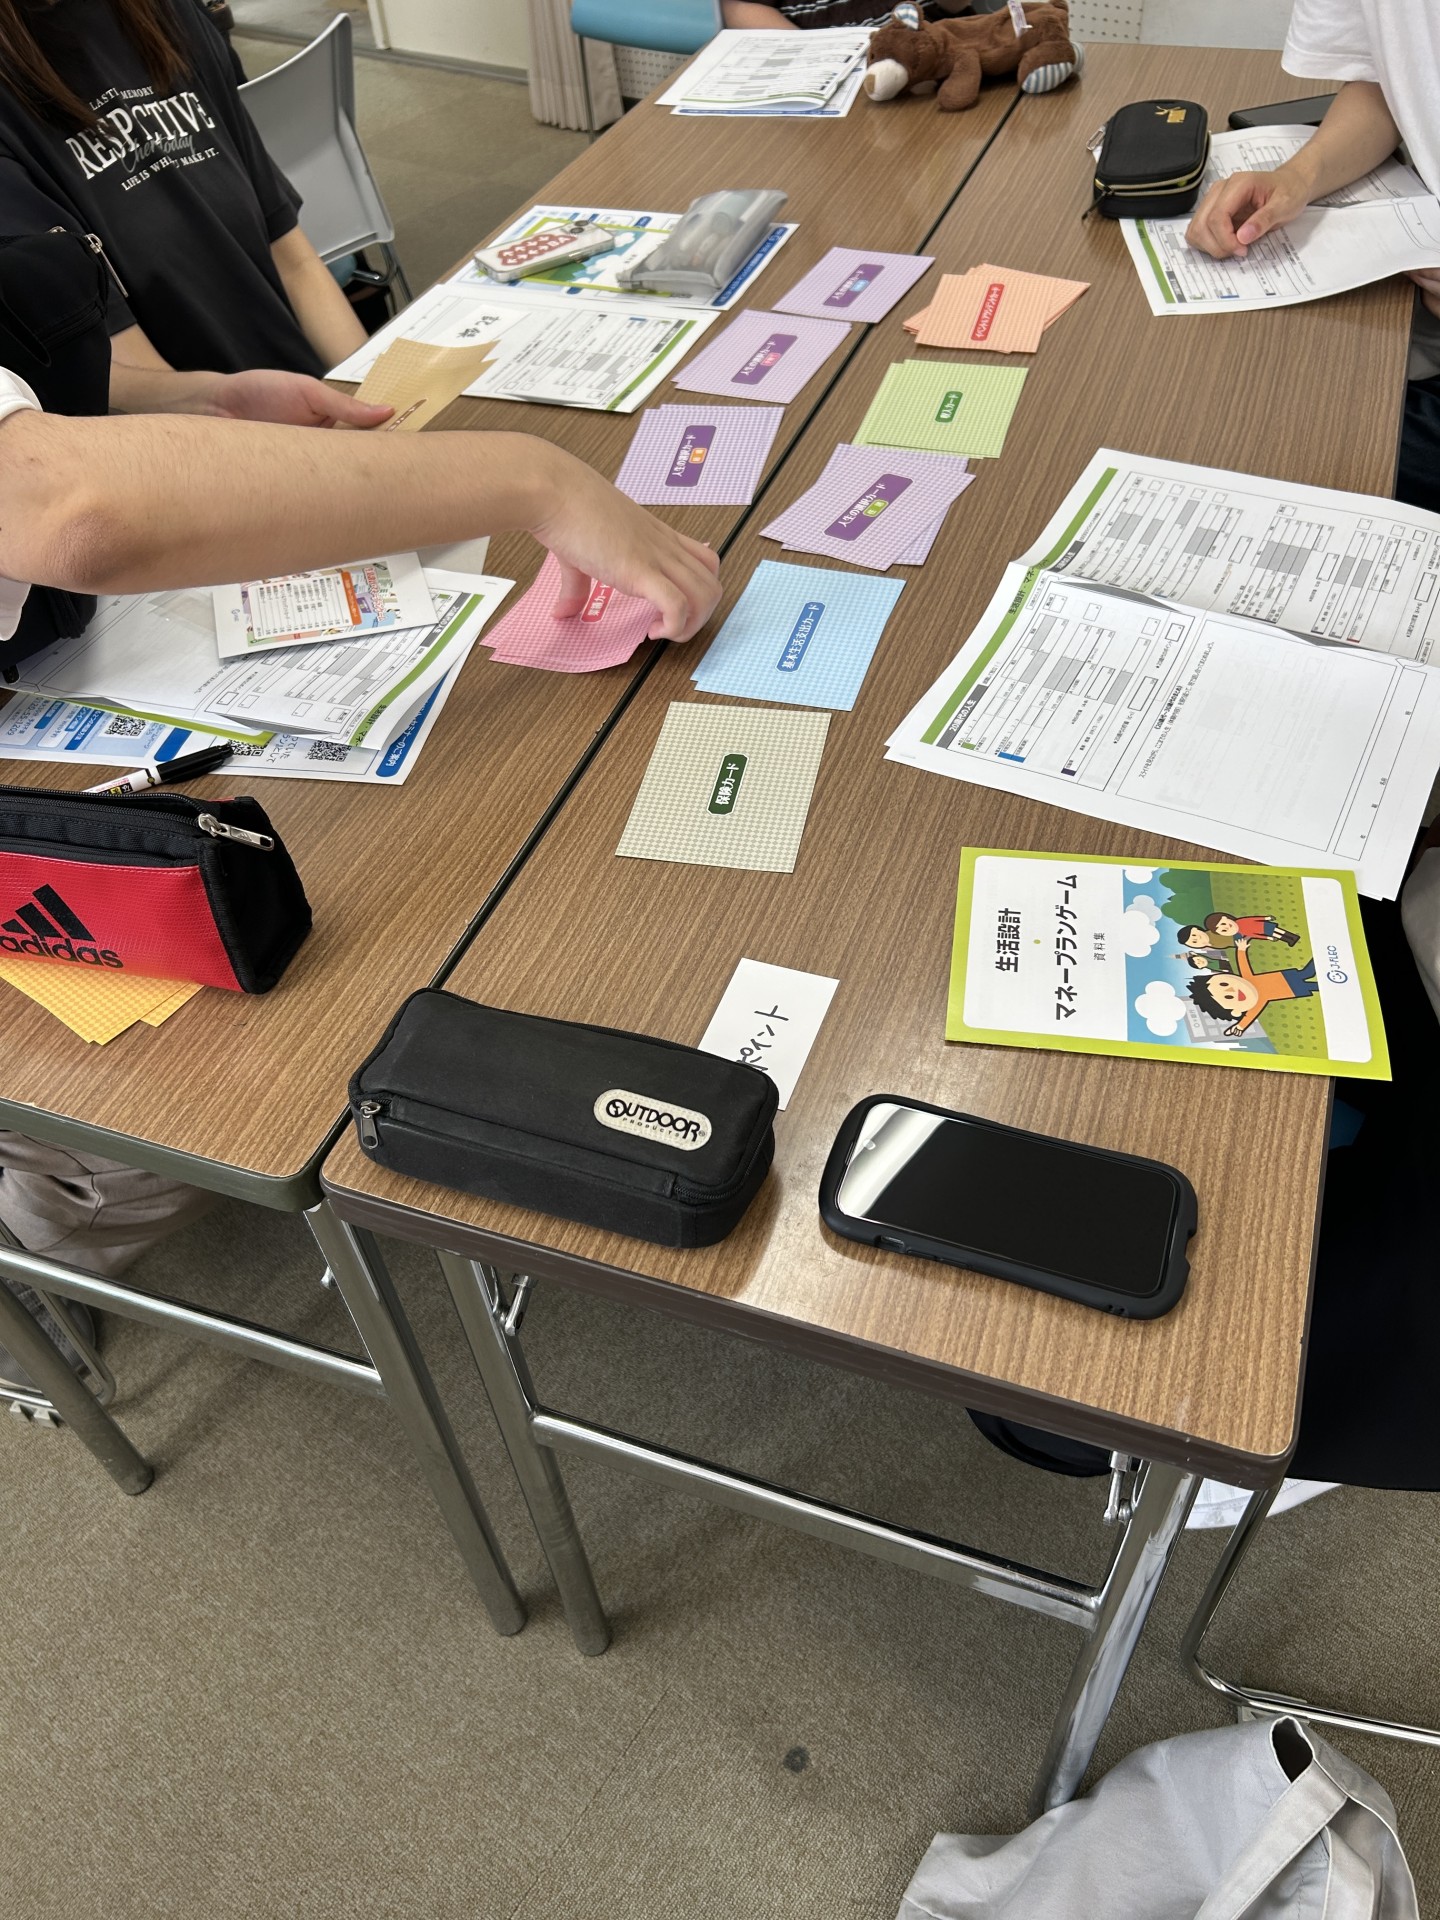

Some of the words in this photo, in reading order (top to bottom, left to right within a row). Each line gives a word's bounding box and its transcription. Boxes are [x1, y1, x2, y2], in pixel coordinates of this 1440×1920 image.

[120, 86, 154, 99] MEMORY
[121, 175, 141, 191] LIFE
[138, 169, 150, 182] IS
[181, 152, 205, 167] MAKE
[672, 434, 697, 478] 人生の選択カード
[838, 483, 888, 528] 人生の選択カード
[781, 603, 820, 669] 基本生活支出カード
[949, 699, 977, 732] 20歳代の人生
[714, 760, 739, 807] 保険カード
[0, 935, 125, 970] adidas
[994, 907, 1022, 973] 生活設計
[1054, 874, 1079, 1021] マネープランゲーム
[1093, 931, 1106, 962] 資料集
[605, 1097, 702, 1142] OUTDOOR
